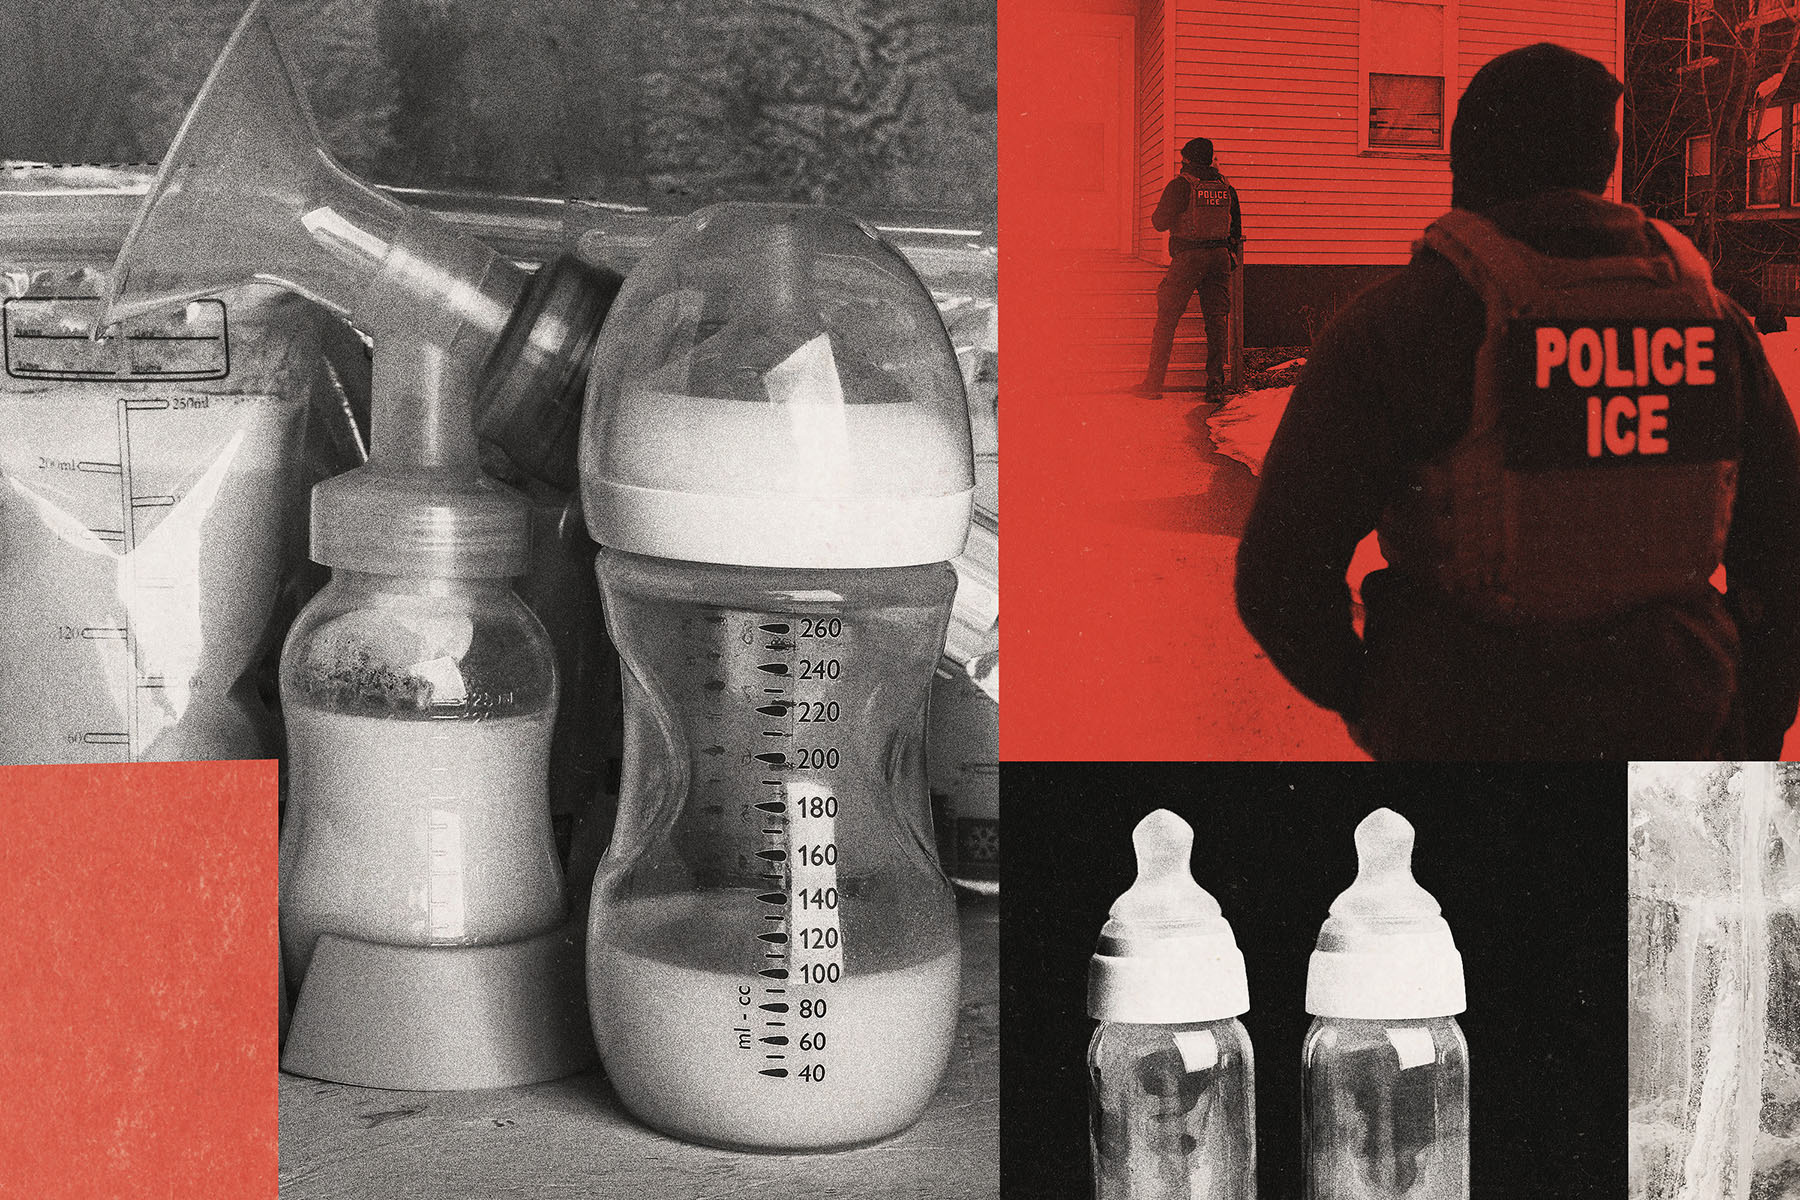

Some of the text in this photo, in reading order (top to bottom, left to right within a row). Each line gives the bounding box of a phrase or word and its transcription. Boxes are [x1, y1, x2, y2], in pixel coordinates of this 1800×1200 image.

[1198, 190, 1228, 199] POLICE
[1535, 327, 1716, 389] POLICE
[172, 396, 209, 410] 250ml
[1587, 394, 1669, 457] ICE
[800, 618, 842, 638] 260
[799, 659, 841, 680] 240
[798, 701, 841, 723] 220
[797, 748, 840, 770] 200
[797, 797, 839, 818] 180
[798, 843, 838, 866] 160
[798, 887, 839, 910] 140
[799, 927, 839, 949] 120
[800, 963, 840, 984] 100
[738, 985, 751, 1006] cc
[799, 999, 827, 1018] 80
[734, 1028, 751, 1050] ml
[799, 1032, 827, 1051] 60
[798, 1064, 826, 1082] 40
